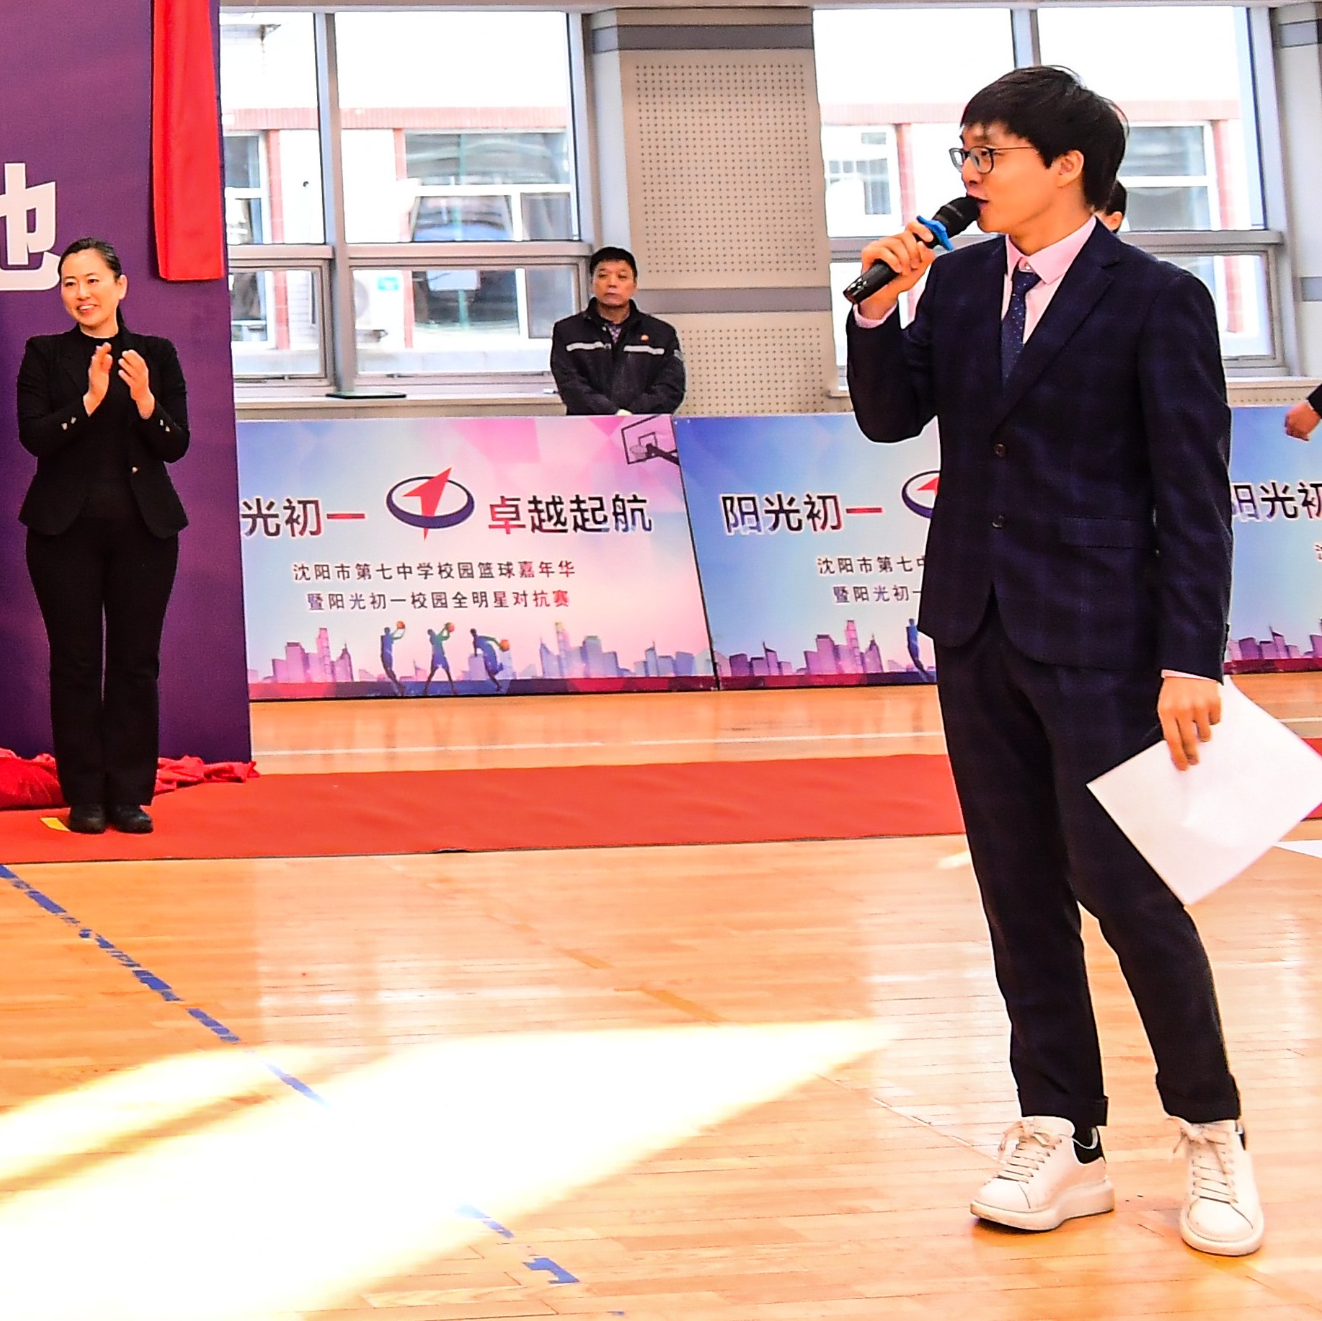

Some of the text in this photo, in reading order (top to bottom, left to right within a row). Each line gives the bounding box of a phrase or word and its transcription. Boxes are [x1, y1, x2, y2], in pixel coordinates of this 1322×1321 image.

[487, 493, 654, 535] 卓越起航
[721, 493, 884, 535] 阳光初一
[292, 559, 576, 582] 沈阳市第七中学校园篮球嘉年华
[306, 589, 570, 613] 暨阳光初一校园全明星对抗赛
